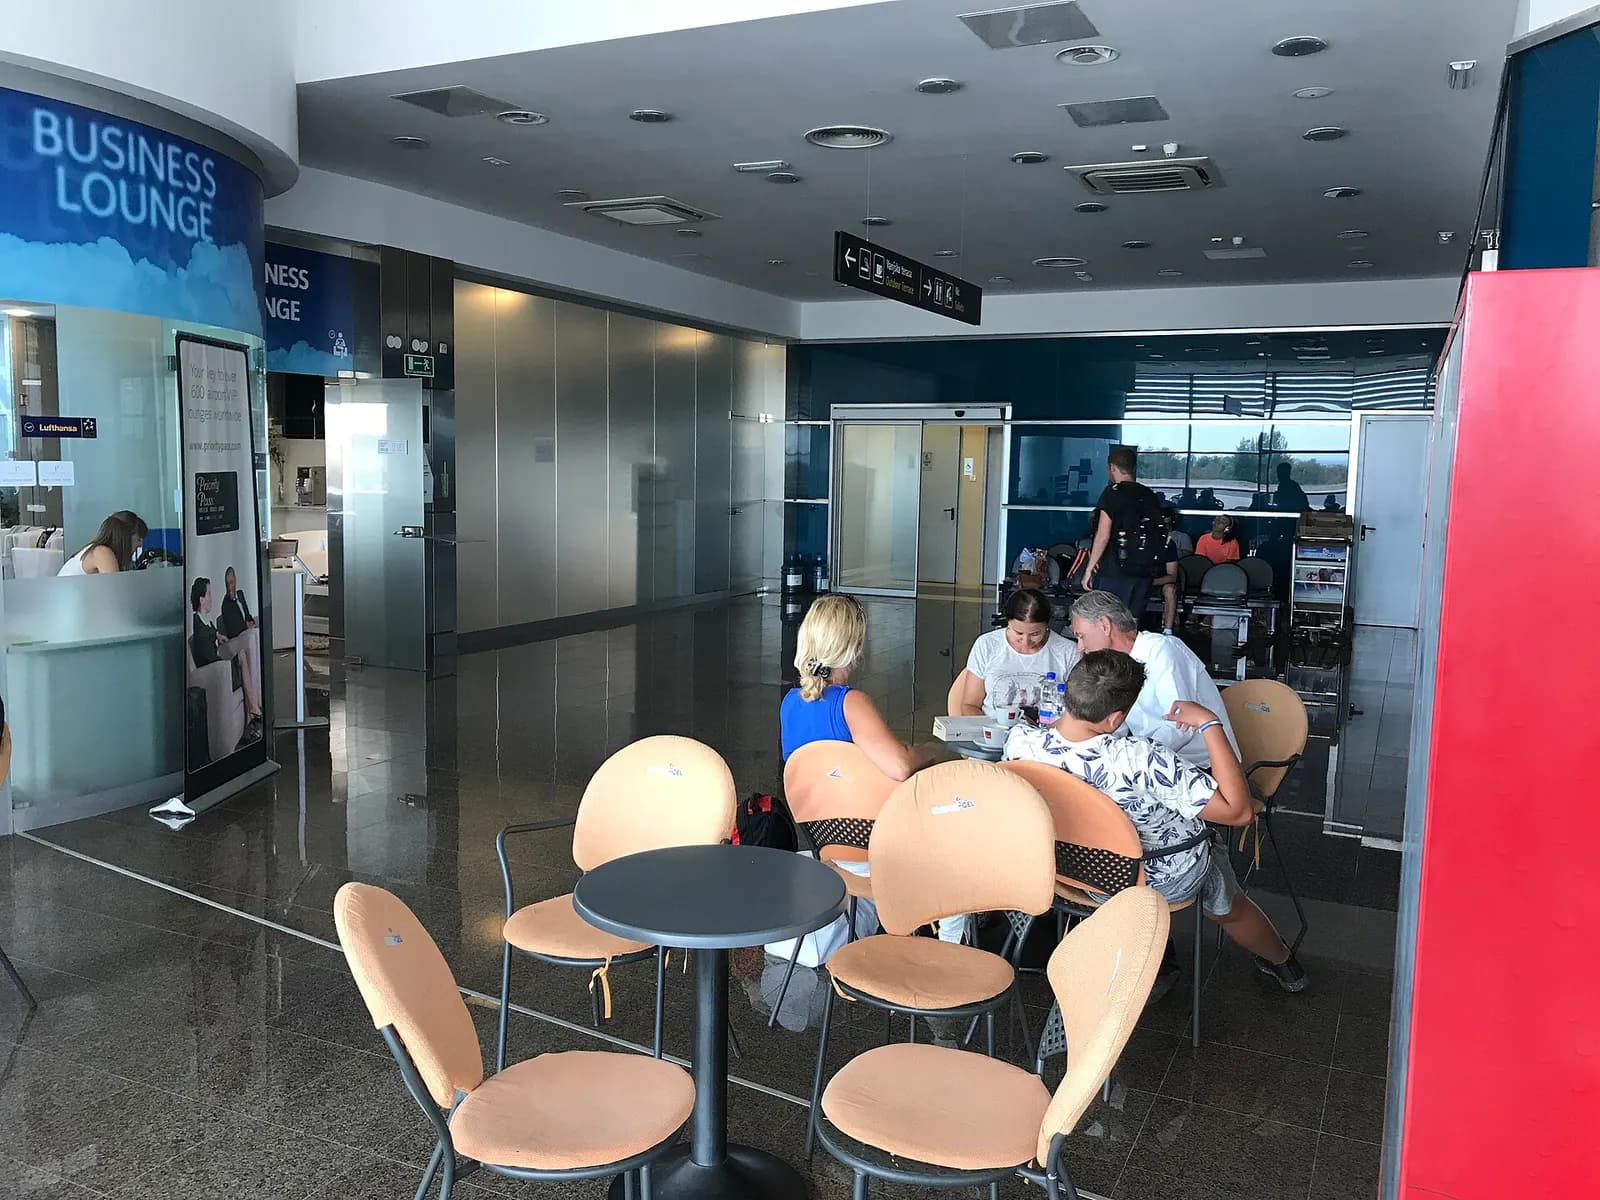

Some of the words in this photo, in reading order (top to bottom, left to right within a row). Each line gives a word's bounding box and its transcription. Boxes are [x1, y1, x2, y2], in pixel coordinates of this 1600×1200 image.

[33, 108, 217, 199] BUSINESS
[56, 166, 213, 241] LOUNGE
[264, 262, 310, 290] NESS
[39, 423, 78, 432] Lufthansa
